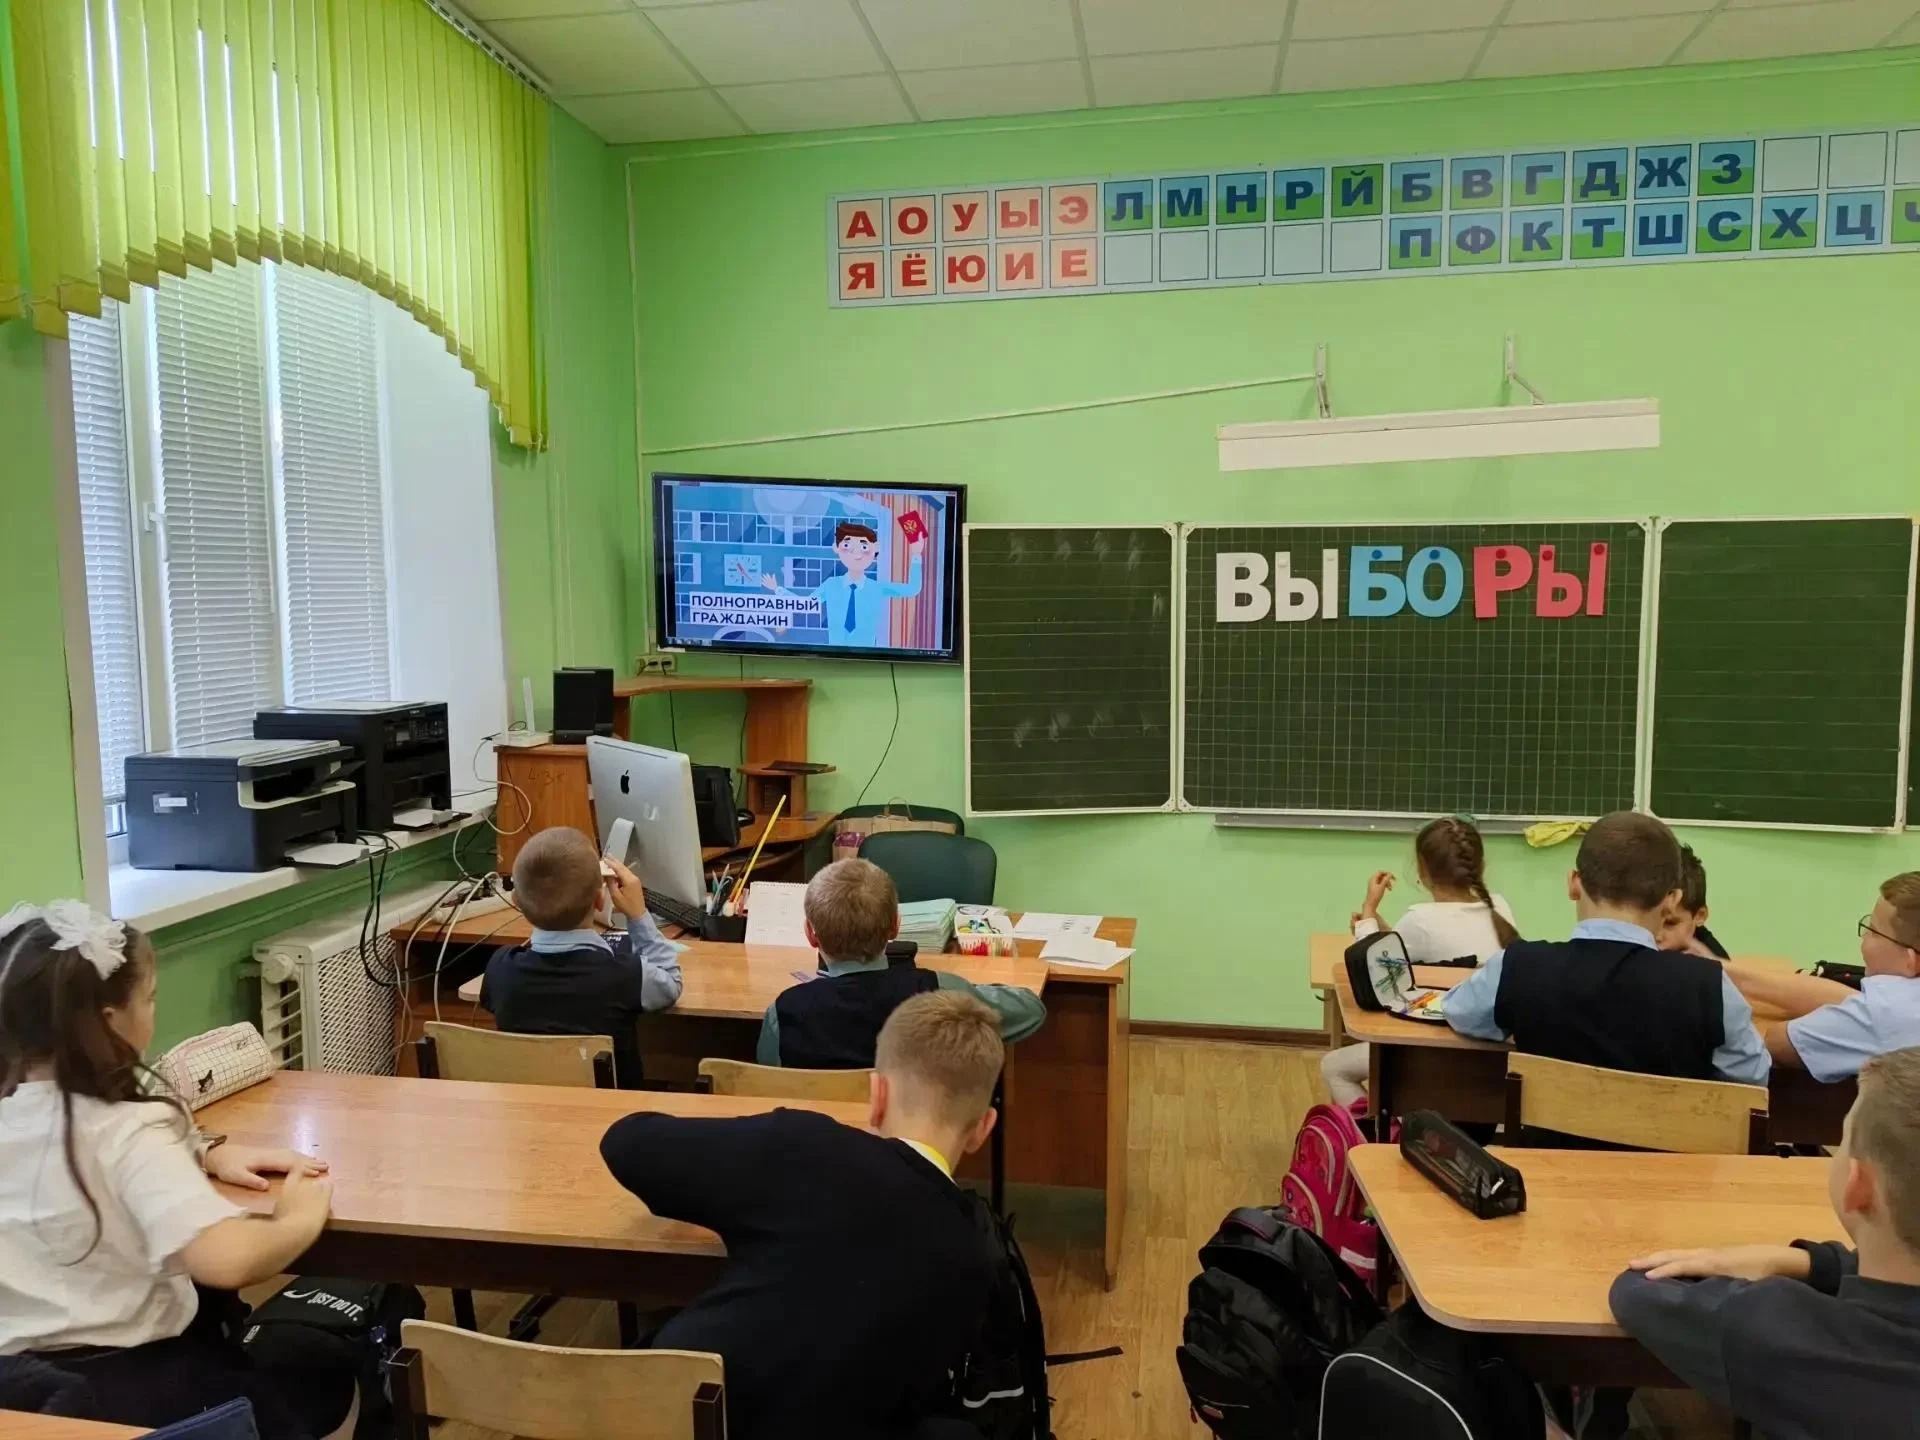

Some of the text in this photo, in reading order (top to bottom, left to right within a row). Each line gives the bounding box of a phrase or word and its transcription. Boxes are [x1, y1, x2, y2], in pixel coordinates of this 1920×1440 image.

[846, 153, 1743, 238] А О У Ы Э Л М Н Р Й Б В Г Д Ж З
[847, 262, 876, 291] Я
[901, 253, 927, 288] Ё
[947, 255, 986, 284] Ю
[1004, 253, 1035, 281] И
[1060, 249, 1088, 278] Е
[1399, 228, 1432, 258] П
[1455, 225, 1496, 255] Ф
[1522, 220, 1555, 252] К
[1582, 217, 1616, 248] Т
[1638, 213, 1683, 246] Ш
[1707, 211, 1742, 242] С
[1770, 207, 1808, 239] Х
[1835, 204, 1875, 241] Ц
[691, 595, 819, 611] ПОЛНОПРАВНЫЙ
[693, 611, 788, 626] ГРАЖДАНИН
[1216, 542, 1608, 622] ВЫБОРЫ
